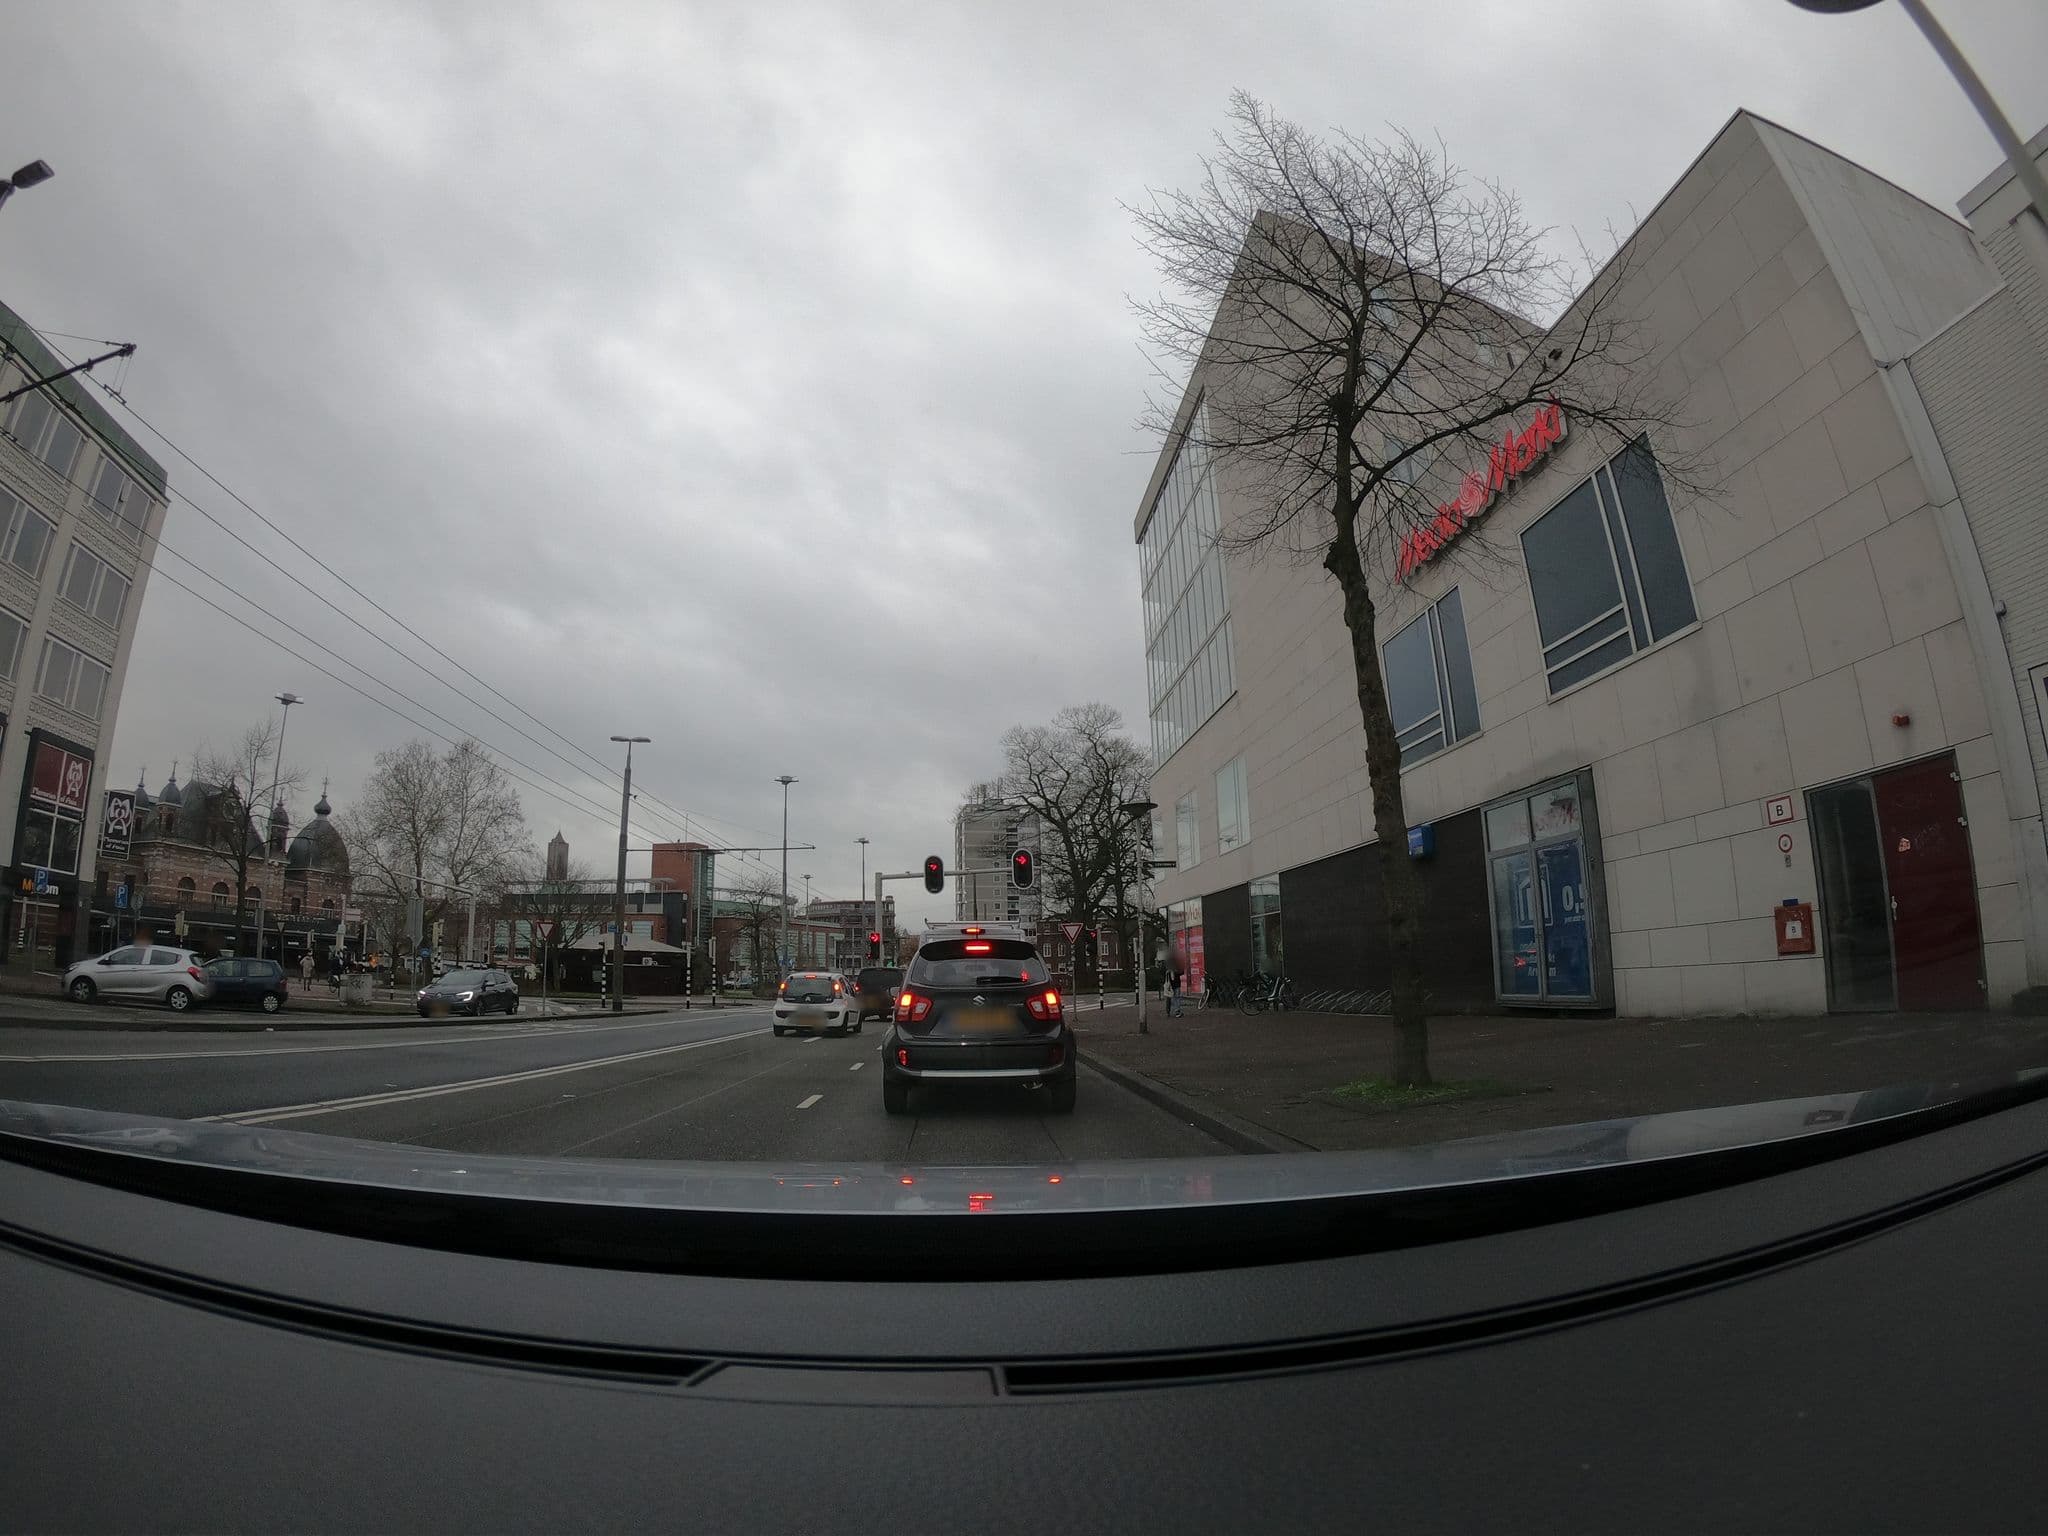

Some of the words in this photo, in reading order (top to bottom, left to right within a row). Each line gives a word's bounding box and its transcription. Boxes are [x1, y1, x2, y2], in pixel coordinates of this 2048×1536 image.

[1776, 804, 1784, 817] B
[37, 870, 46, 883] P
[118, 886, 125, 896] P
